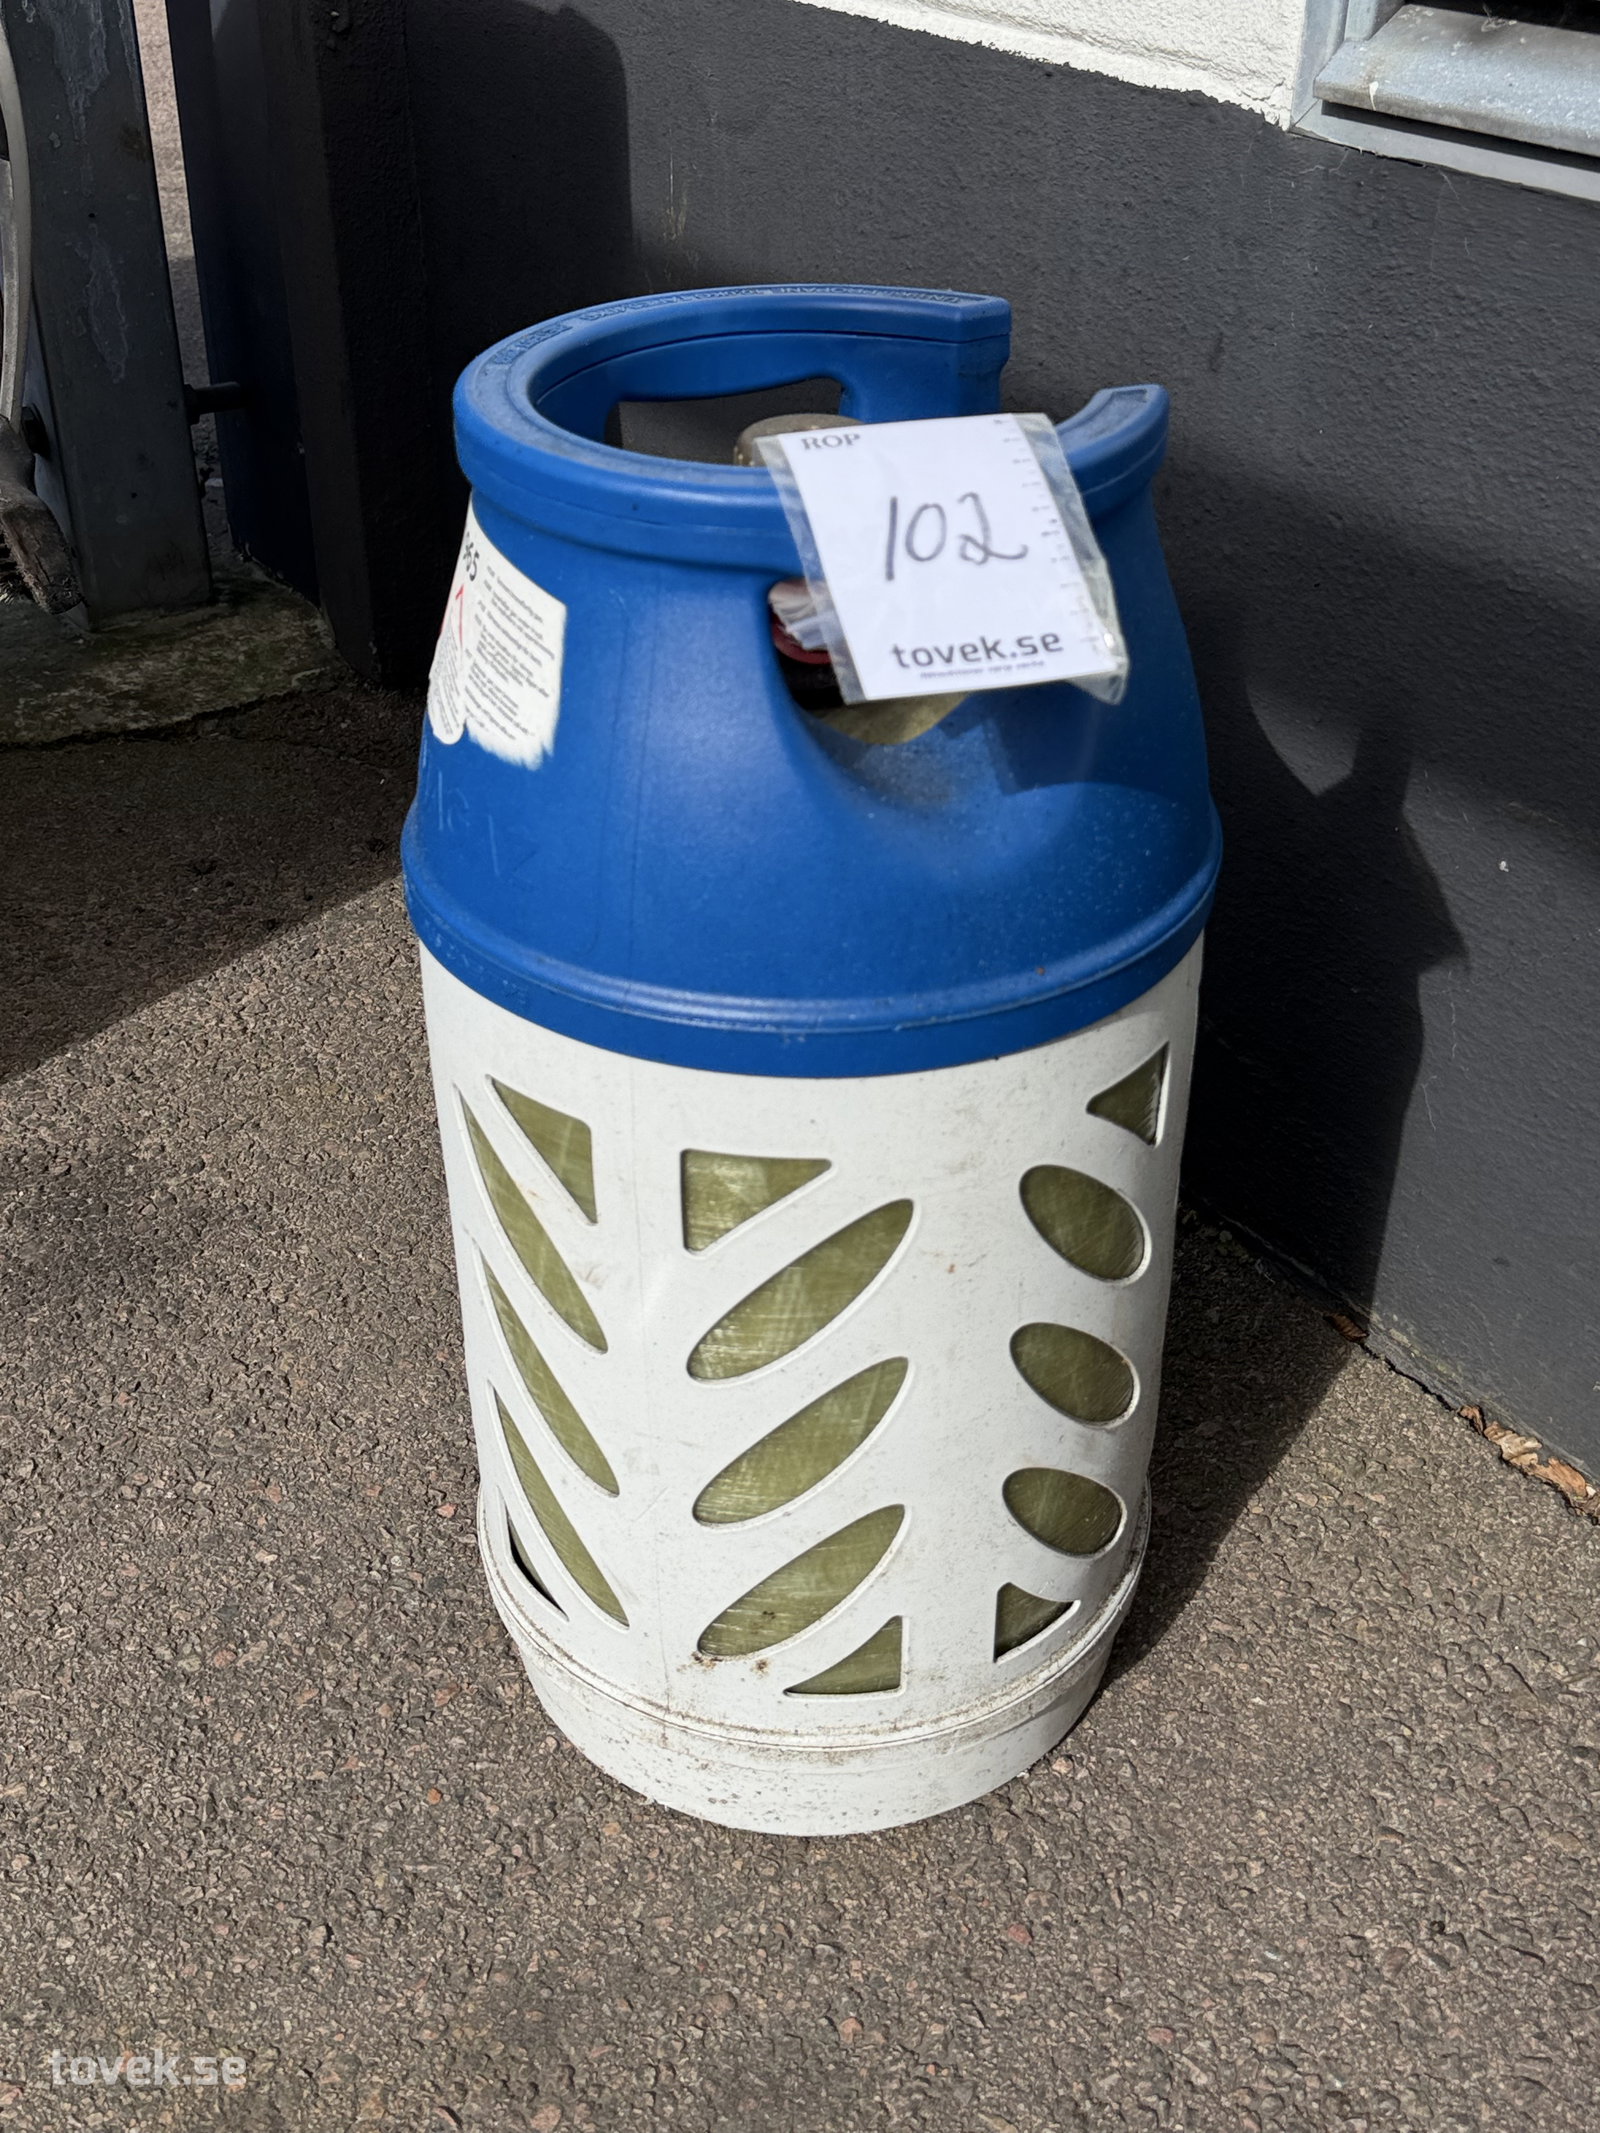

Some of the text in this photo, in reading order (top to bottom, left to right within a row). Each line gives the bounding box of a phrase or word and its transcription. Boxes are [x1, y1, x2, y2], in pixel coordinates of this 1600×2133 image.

[800, 432, 861, 451] ROP
[883, 491, 1029, 582] 102
[891, 630, 1065, 669] tovek.se
